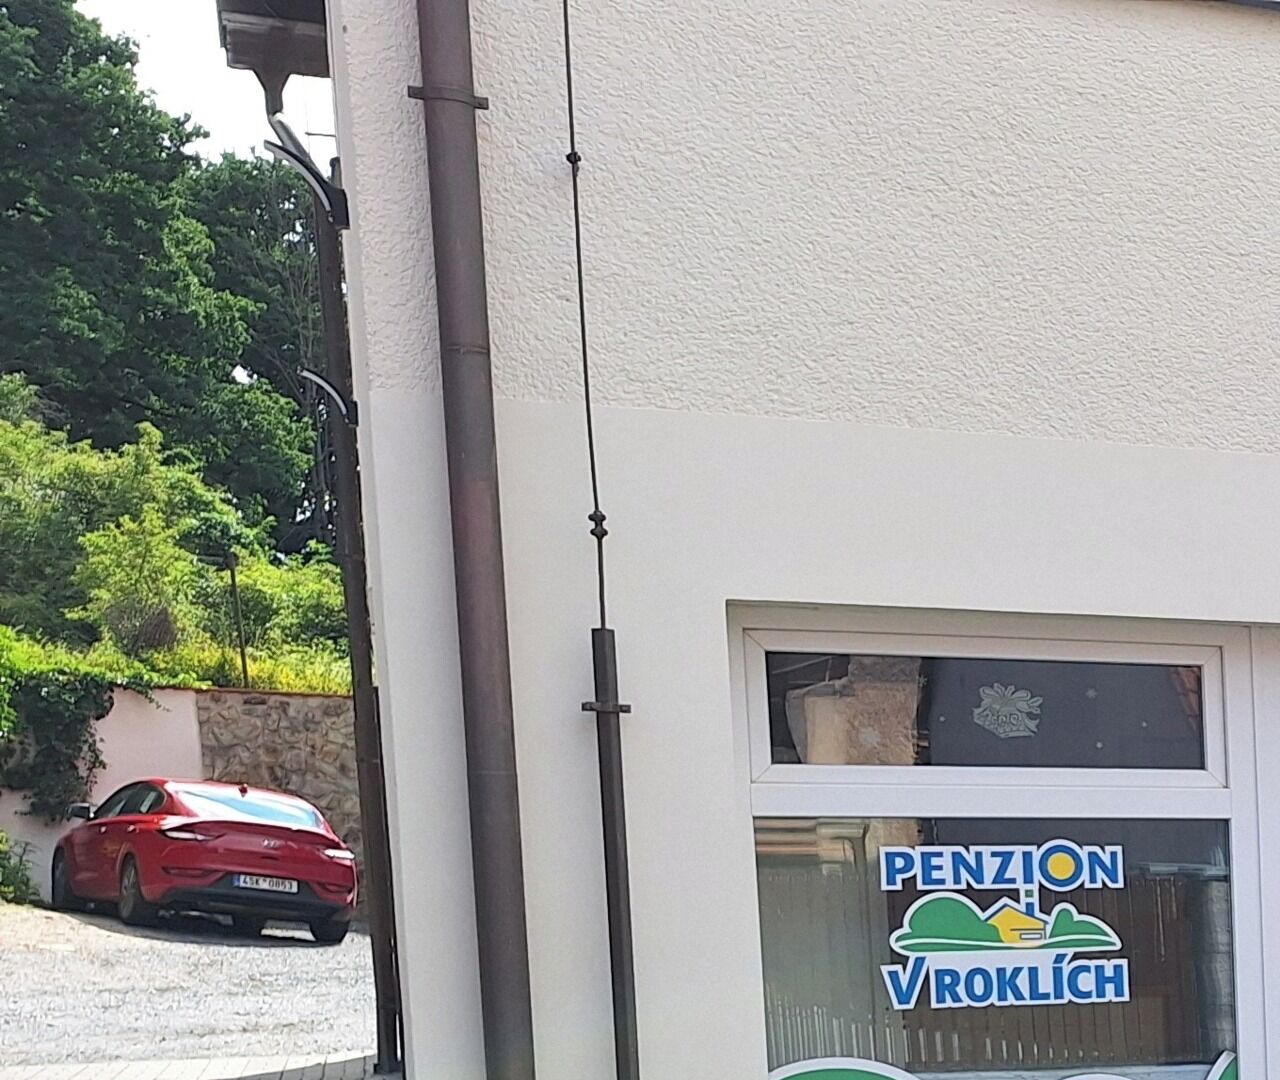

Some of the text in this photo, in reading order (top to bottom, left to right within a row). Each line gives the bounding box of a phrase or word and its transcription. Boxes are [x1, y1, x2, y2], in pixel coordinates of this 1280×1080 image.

[884, 844, 1119, 888] PENZION
[887, 953, 1125, 1006] V ROKLÍCH
